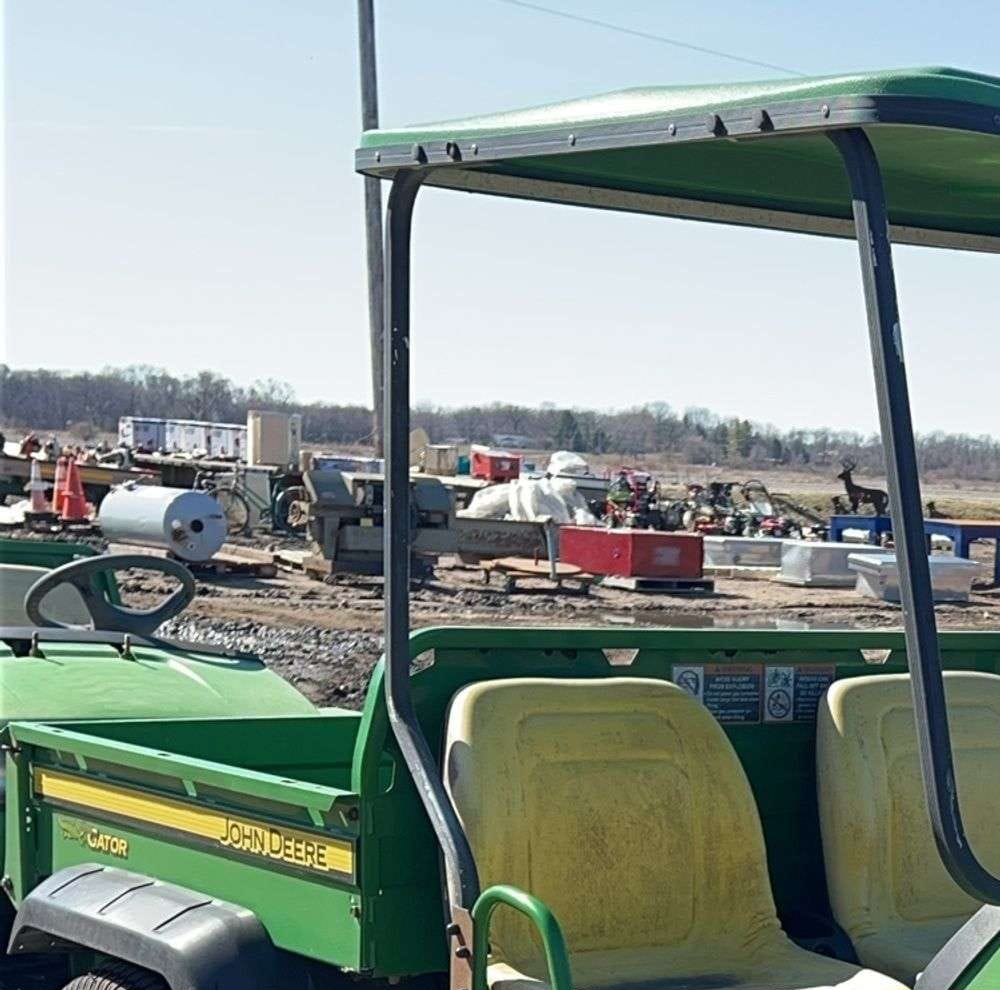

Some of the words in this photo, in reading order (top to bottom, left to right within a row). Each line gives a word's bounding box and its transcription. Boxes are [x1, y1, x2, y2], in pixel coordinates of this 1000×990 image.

[86, 828, 128, 857] GATOR
[220, 817, 265, 852] JOHN
[269, 828, 327, 867] DEERE
